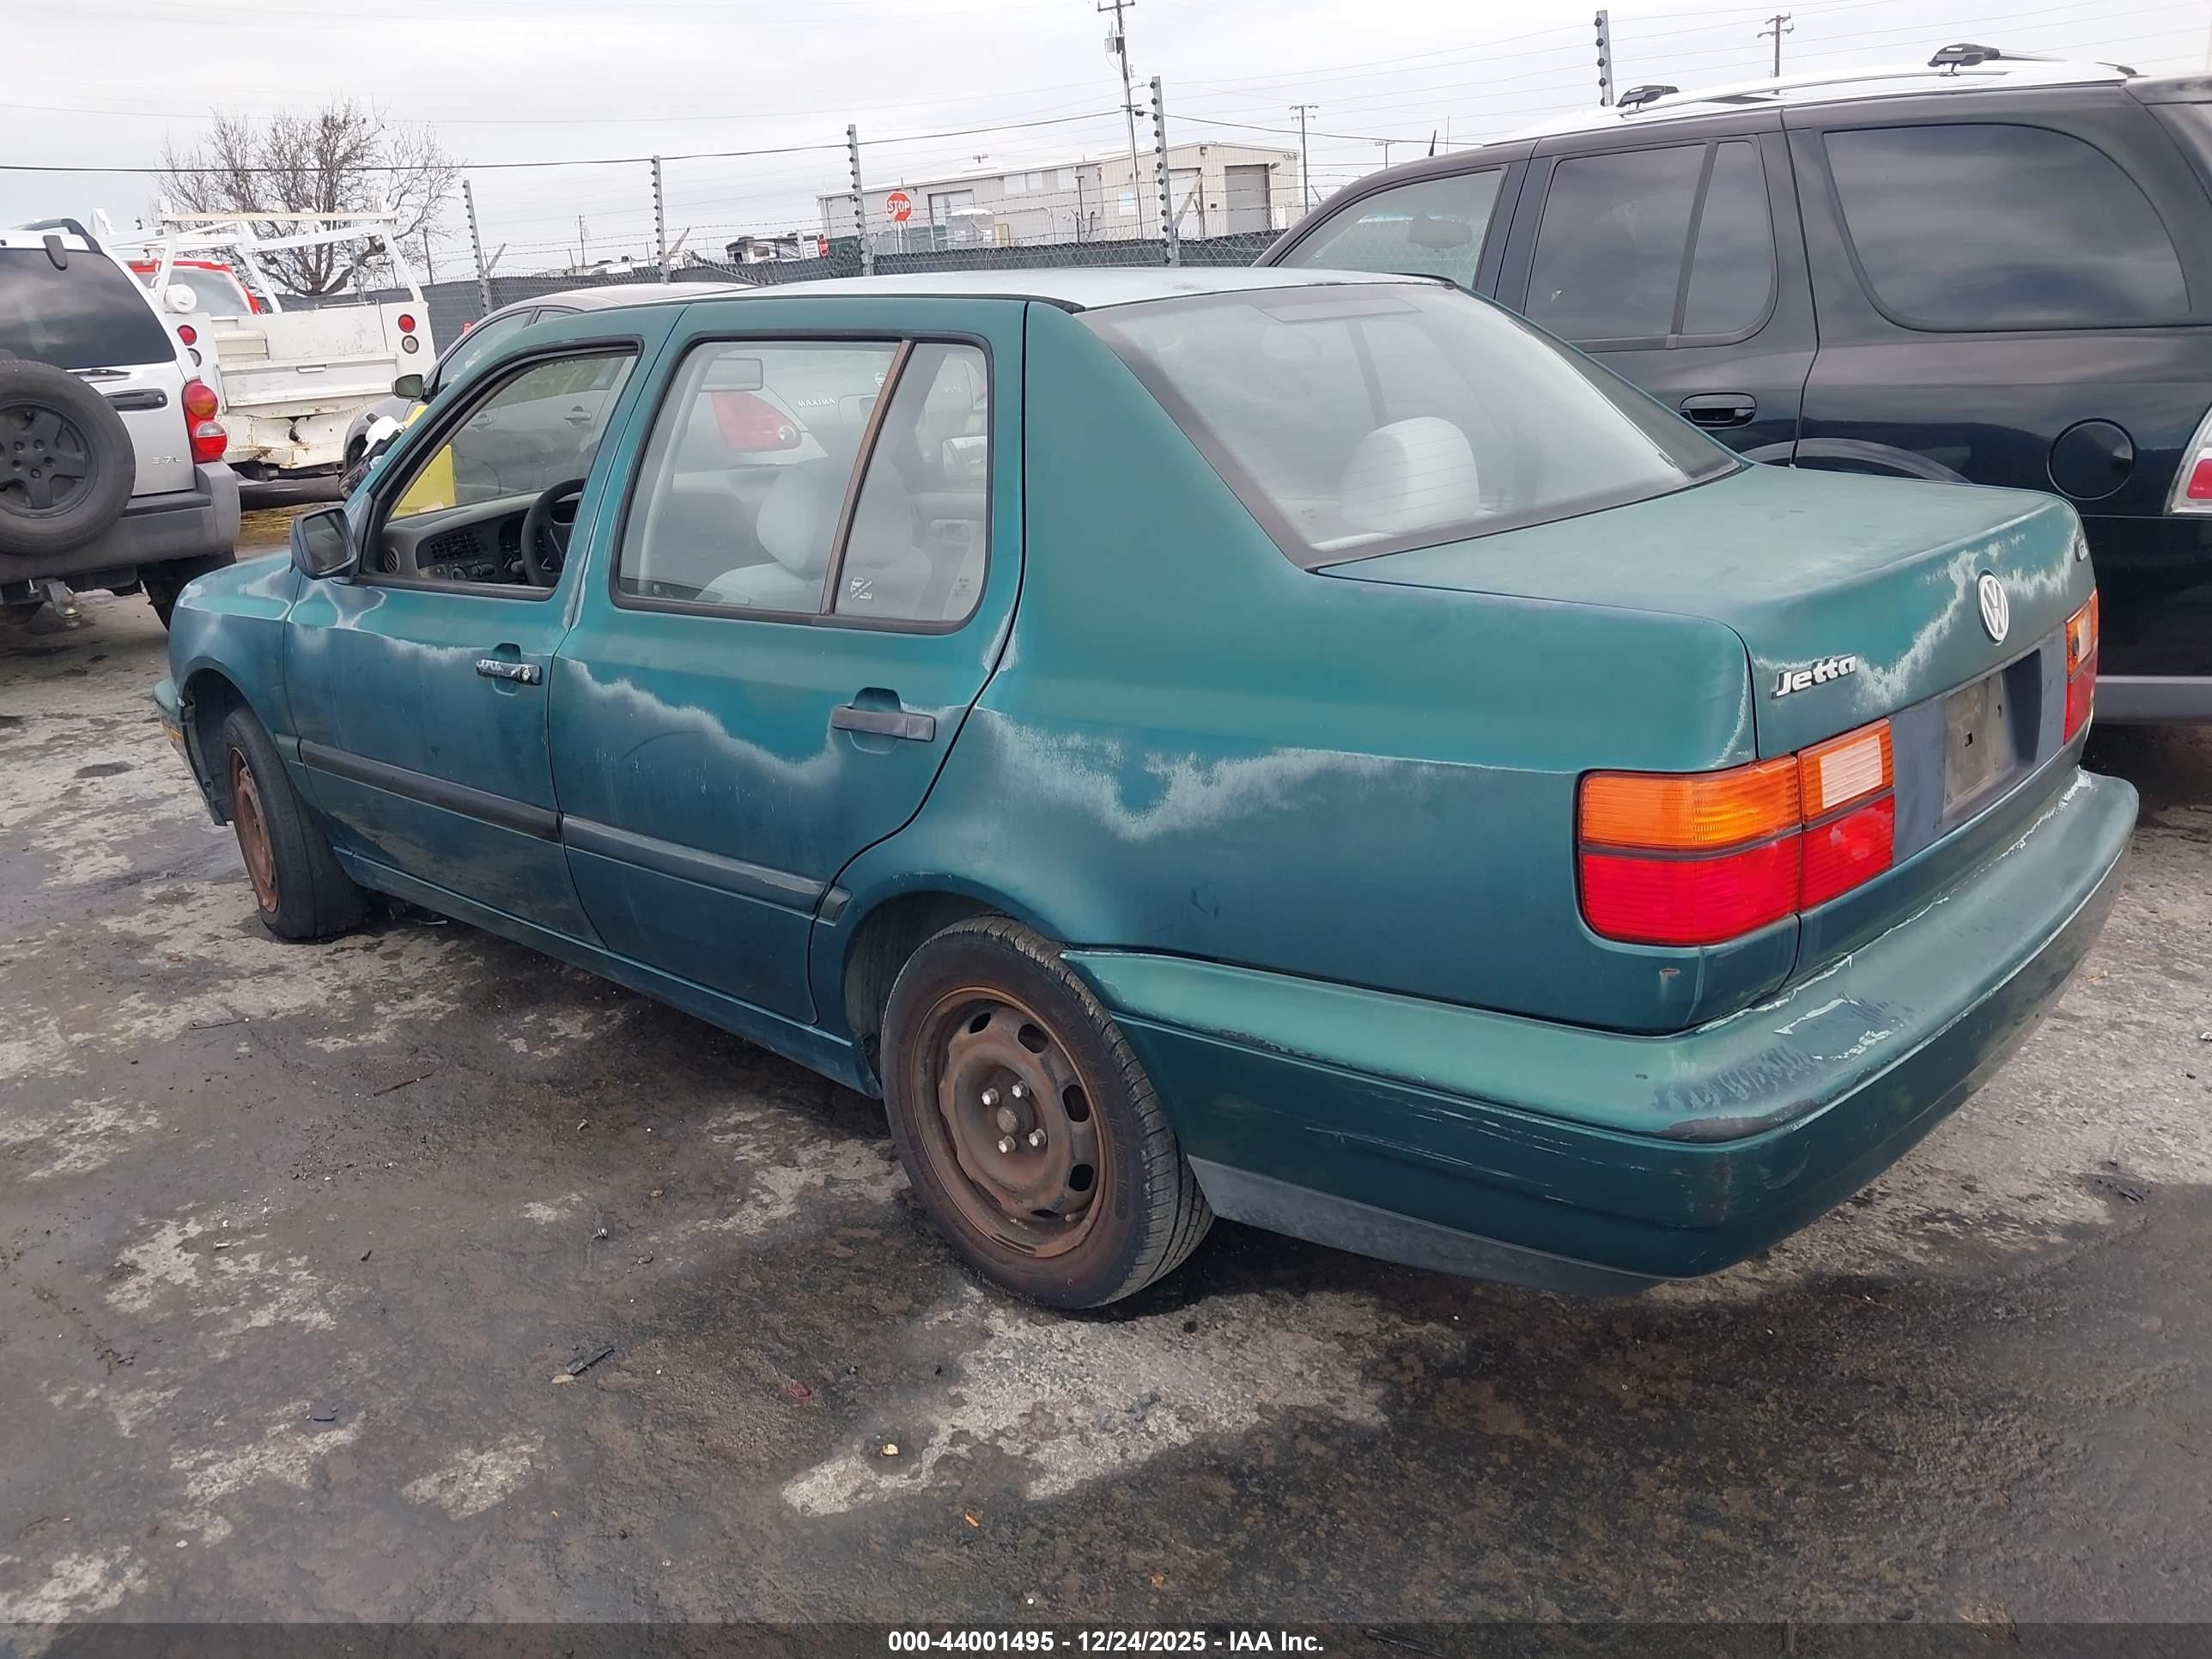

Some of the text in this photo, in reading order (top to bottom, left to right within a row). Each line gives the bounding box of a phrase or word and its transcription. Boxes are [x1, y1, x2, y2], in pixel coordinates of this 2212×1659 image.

[887, 199, 910, 213] STOP
[798, 398, 836, 407] MAXIMA
[1772, 655, 1856, 698] Jetta
